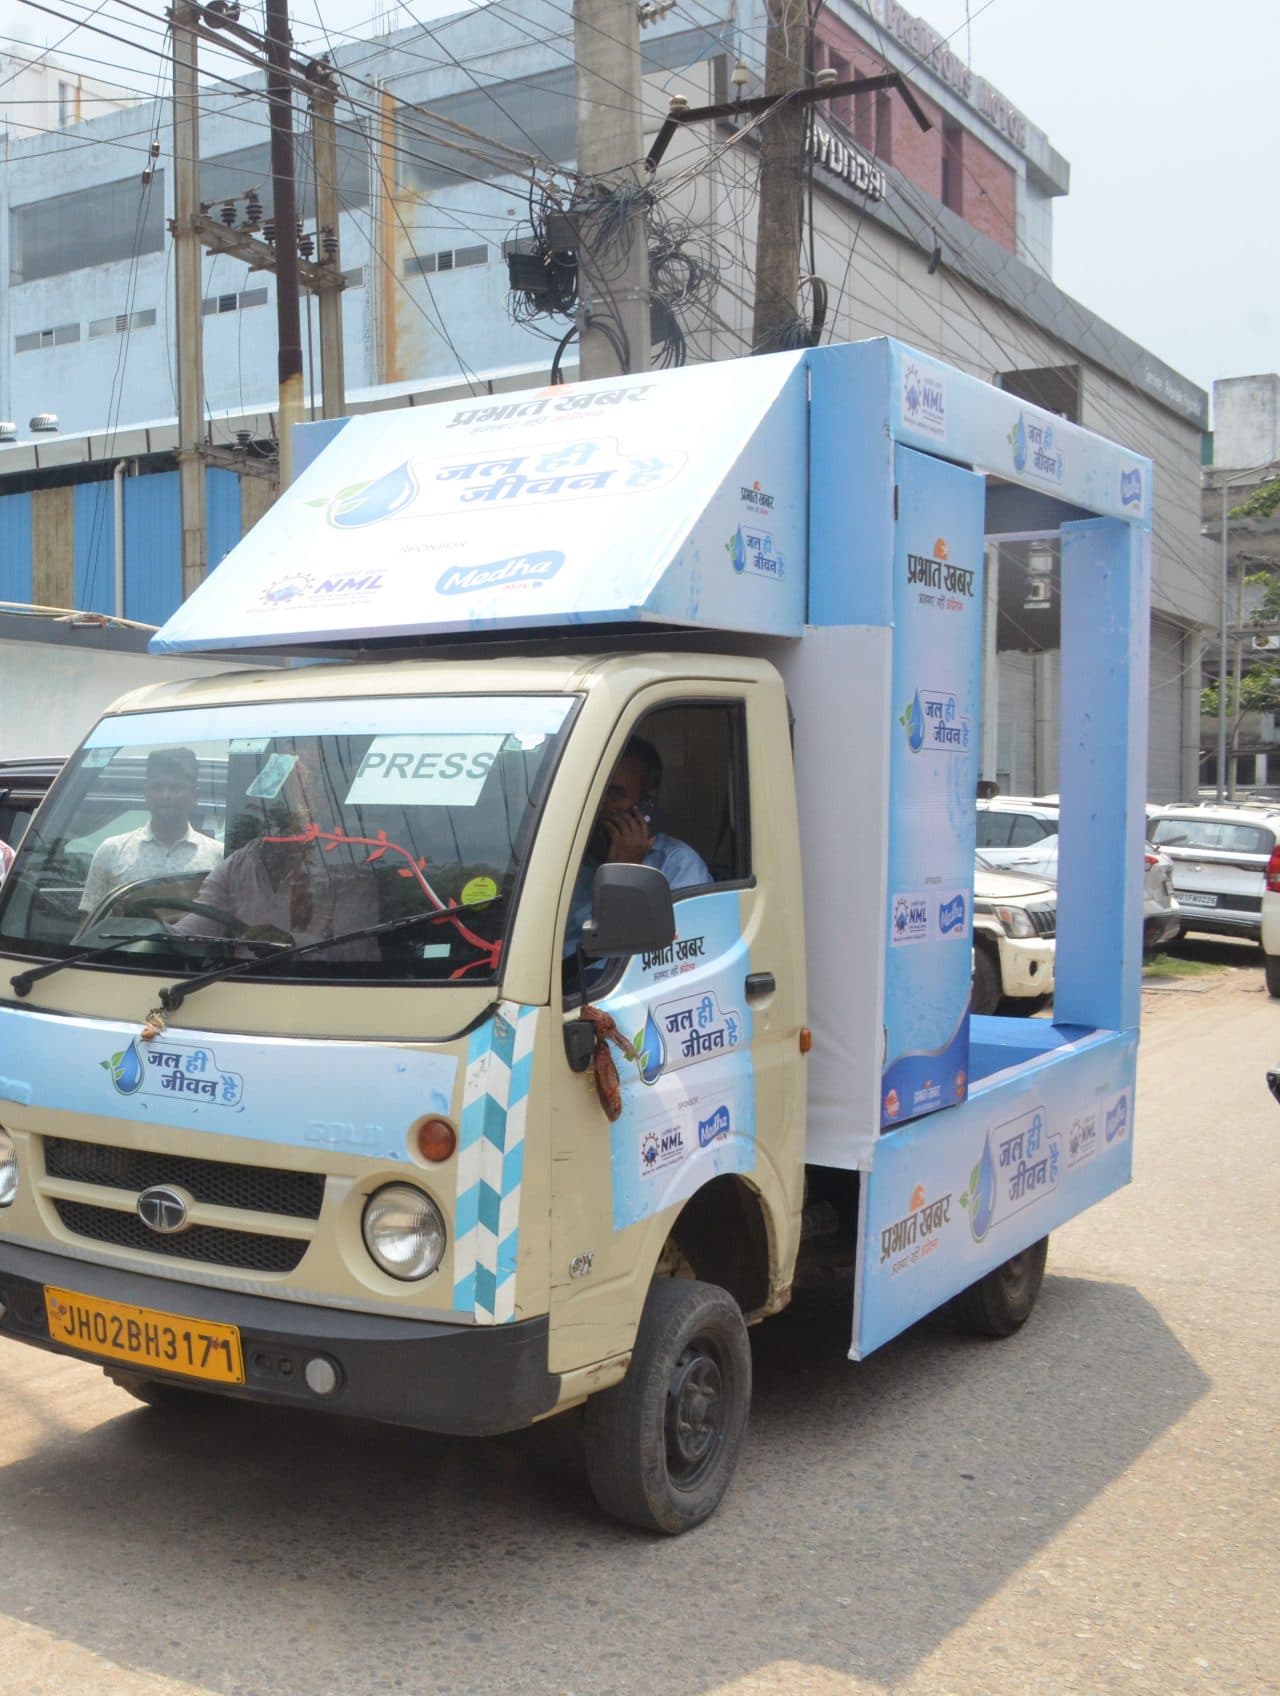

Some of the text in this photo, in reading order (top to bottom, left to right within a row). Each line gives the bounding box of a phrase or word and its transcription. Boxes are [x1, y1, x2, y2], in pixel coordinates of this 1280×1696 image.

[445, 384, 660, 429] प्रभात खबर
[1028, 424, 1042, 446] जल
[436, 442, 600, 481] जल ही
[460, 456, 674, 503] जीवन है
[746, 535, 761, 550] जल
[443, 558, 553, 591] Medha
[754, 552, 777, 573] जीवन
[907, 553, 975, 597] प्रभात खबर
[314, 575, 383, 594] NML
[925, 697, 955, 723] जल ही
[933, 721, 969, 747] जीवन है
[356, 752, 495, 779] PRESS
[909, 907, 927, 923] NML
[642, 936, 705, 972] प्रभात खबर
[665, 995, 714, 1033] जल ही
[681, 1017, 738, 1057] जीवन है
[147, 1050, 208, 1073] जल ही
[161, 1070, 238, 1101] जीवन है
[661, 1132, 683, 1152] NML
[701, 1113, 728, 1143] Medha
[999, 1132, 1024, 1168] जल
[1027, 1114, 1042, 1158] ही
[1008, 1159, 1048, 1200] जीवन
[1049, 1141, 1060, 1183] है
[880, 1193, 953, 1264] प्रभात खबर
[64, 1304, 233, 1373] JH02BH3171
